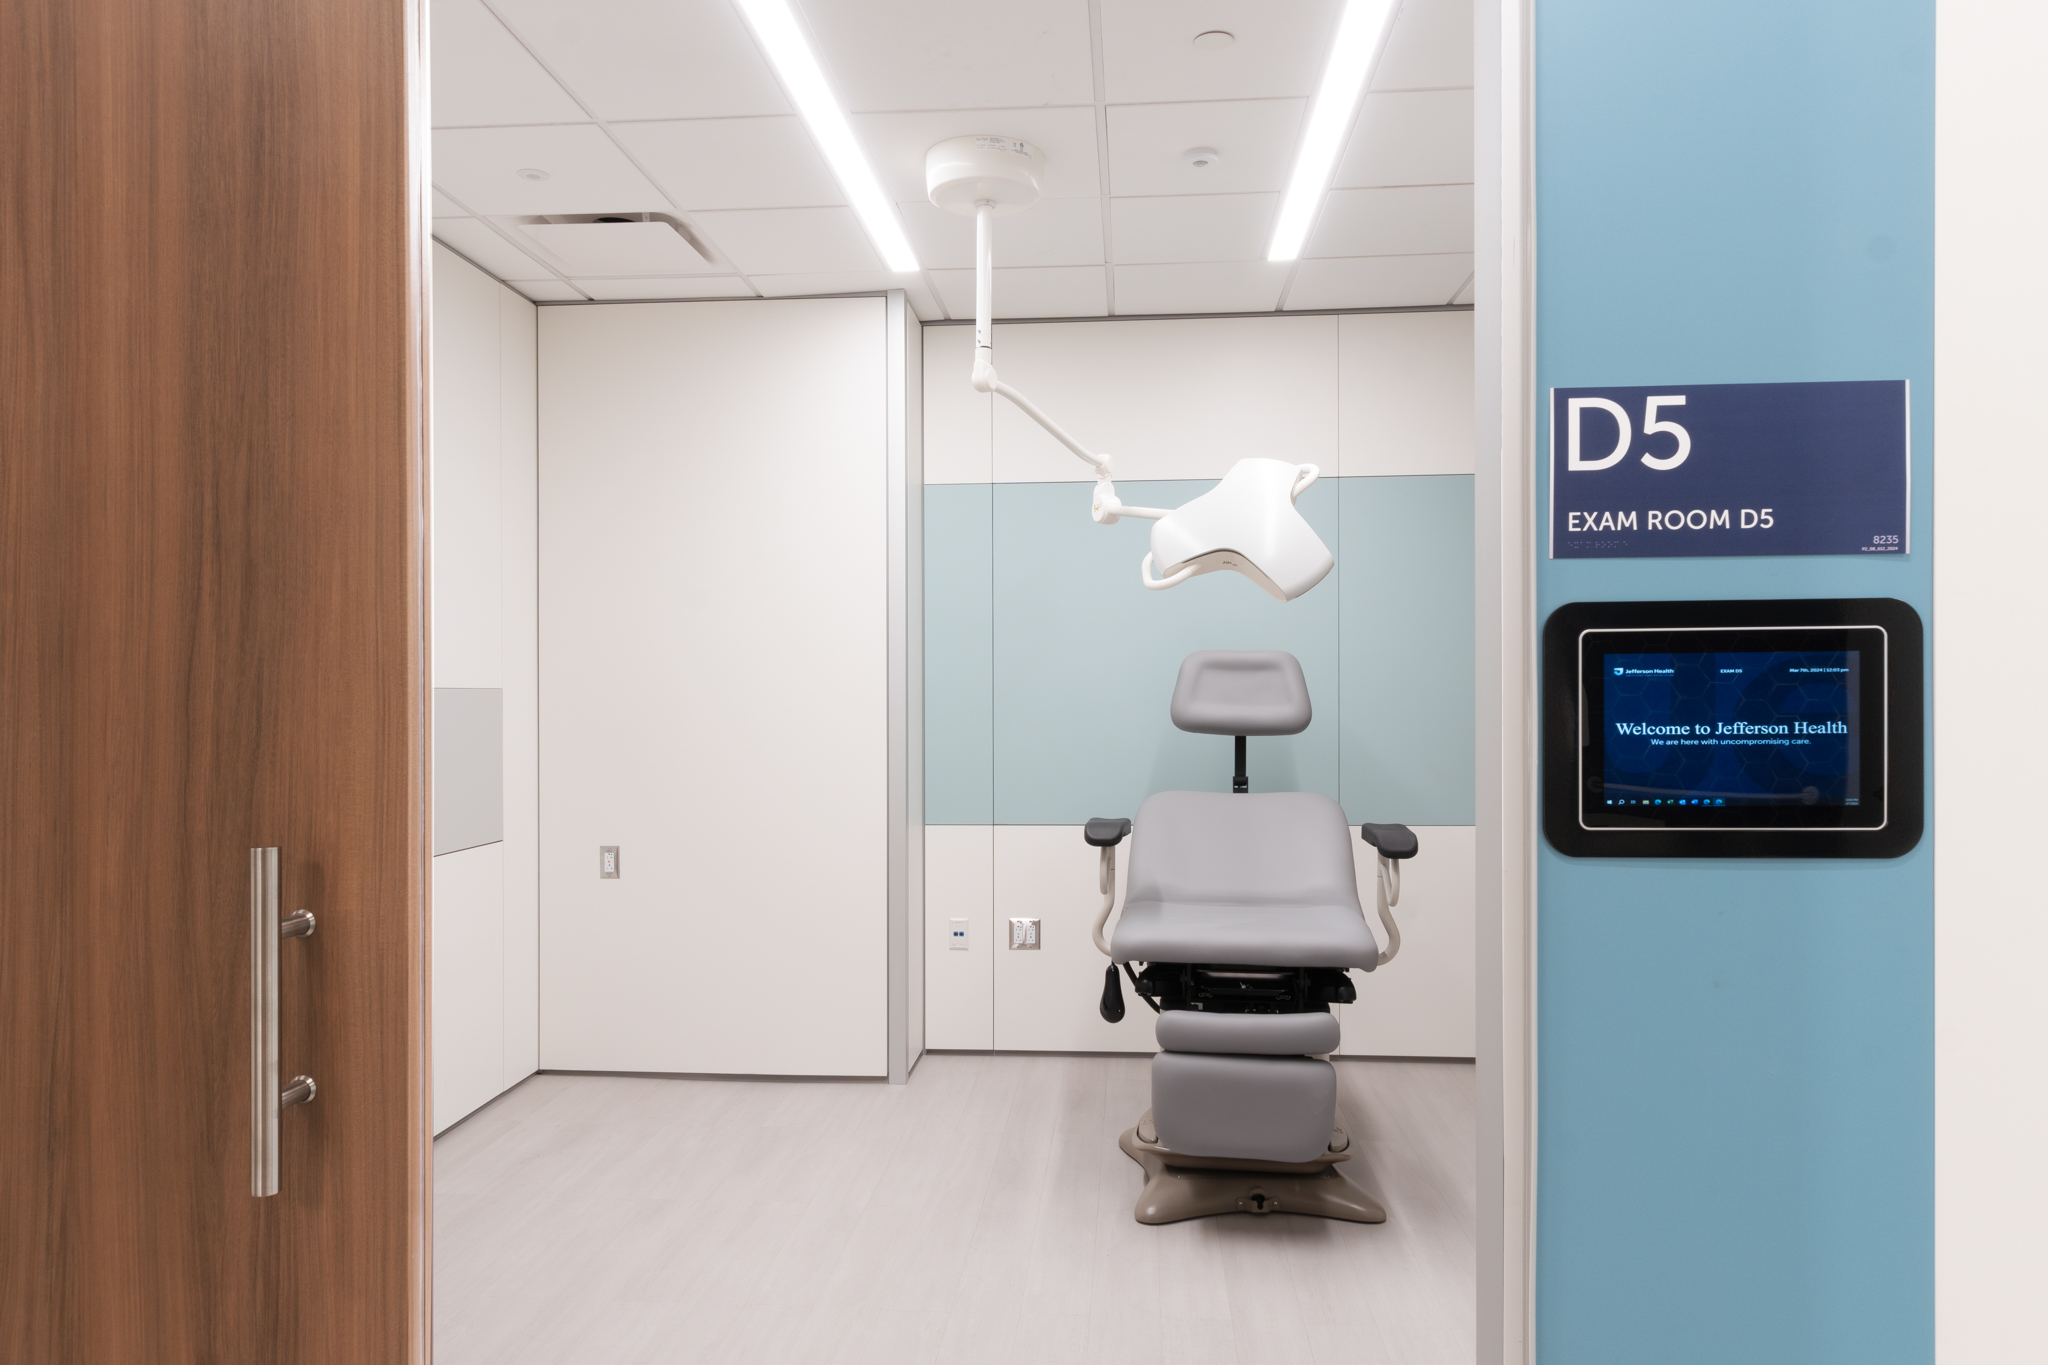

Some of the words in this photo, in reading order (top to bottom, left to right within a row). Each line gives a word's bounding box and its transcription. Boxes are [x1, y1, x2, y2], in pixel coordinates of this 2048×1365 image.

[1568, 395, 1692, 471] D5
[1568, 511, 1638, 532] EXAM
[1648, 509, 1730, 530] ROOM
[1740, 508, 1775, 529] D5
[1873, 535, 1899, 544] 8235
[1616, 722, 1690, 735] Welcome
[1695, 724, 1711, 735] to
[1715, 722, 1789, 735] Jefferson
[1793, 721, 1848, 734] Health
[1720, 738, 1789, 746] uncompromising
